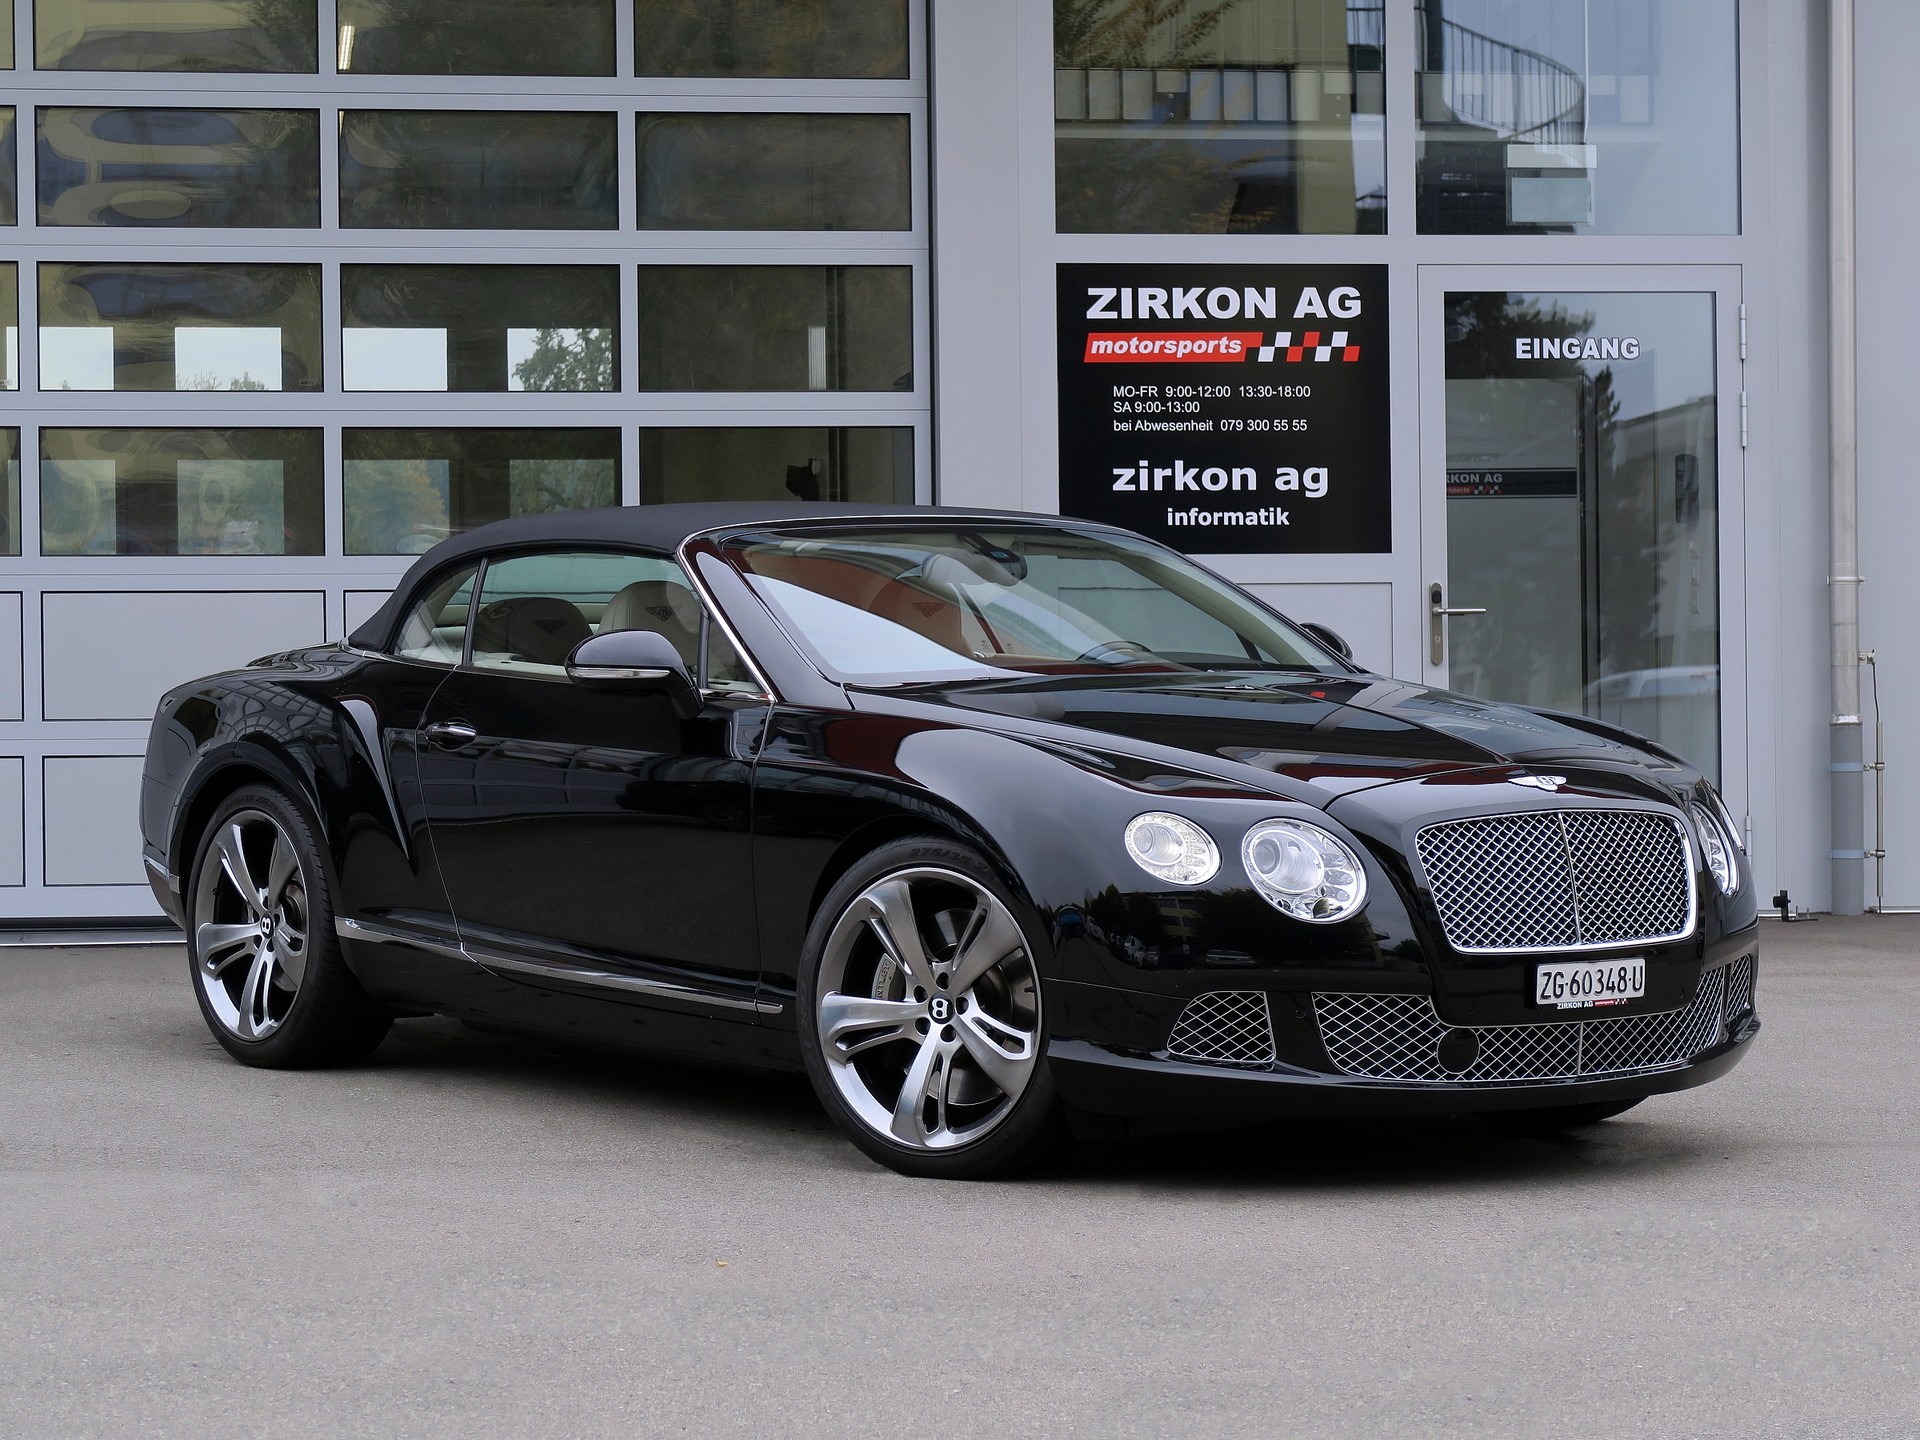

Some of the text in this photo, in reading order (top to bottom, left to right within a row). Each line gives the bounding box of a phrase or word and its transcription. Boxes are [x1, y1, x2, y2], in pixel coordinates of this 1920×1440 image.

[1086, 286, 1362, 319] ZIRKON AG
[1091, 336, 1242, 358] motorsports
[1516, 337, 1640, 359] EINGANG
[1113, 386, 1311, 398] MO-FR 9:00-12:00 13:30-18:00
[1113, 402, 1200, 413] SA 9:00-13:00
[1113, 420, 1308, 432] bei Abwesenheit 079 300 55 55
[1112, 460, 1329, 498] zirkon ag
[1484, 473, 1503, 483] AG
[1167, 507, 1290, 526] informatik
[876, 958, 889, 995] NTLEY
[1557, 1000, 1583, 1010] ZIRKON
[1583, 999, 1594, 1008] AG
